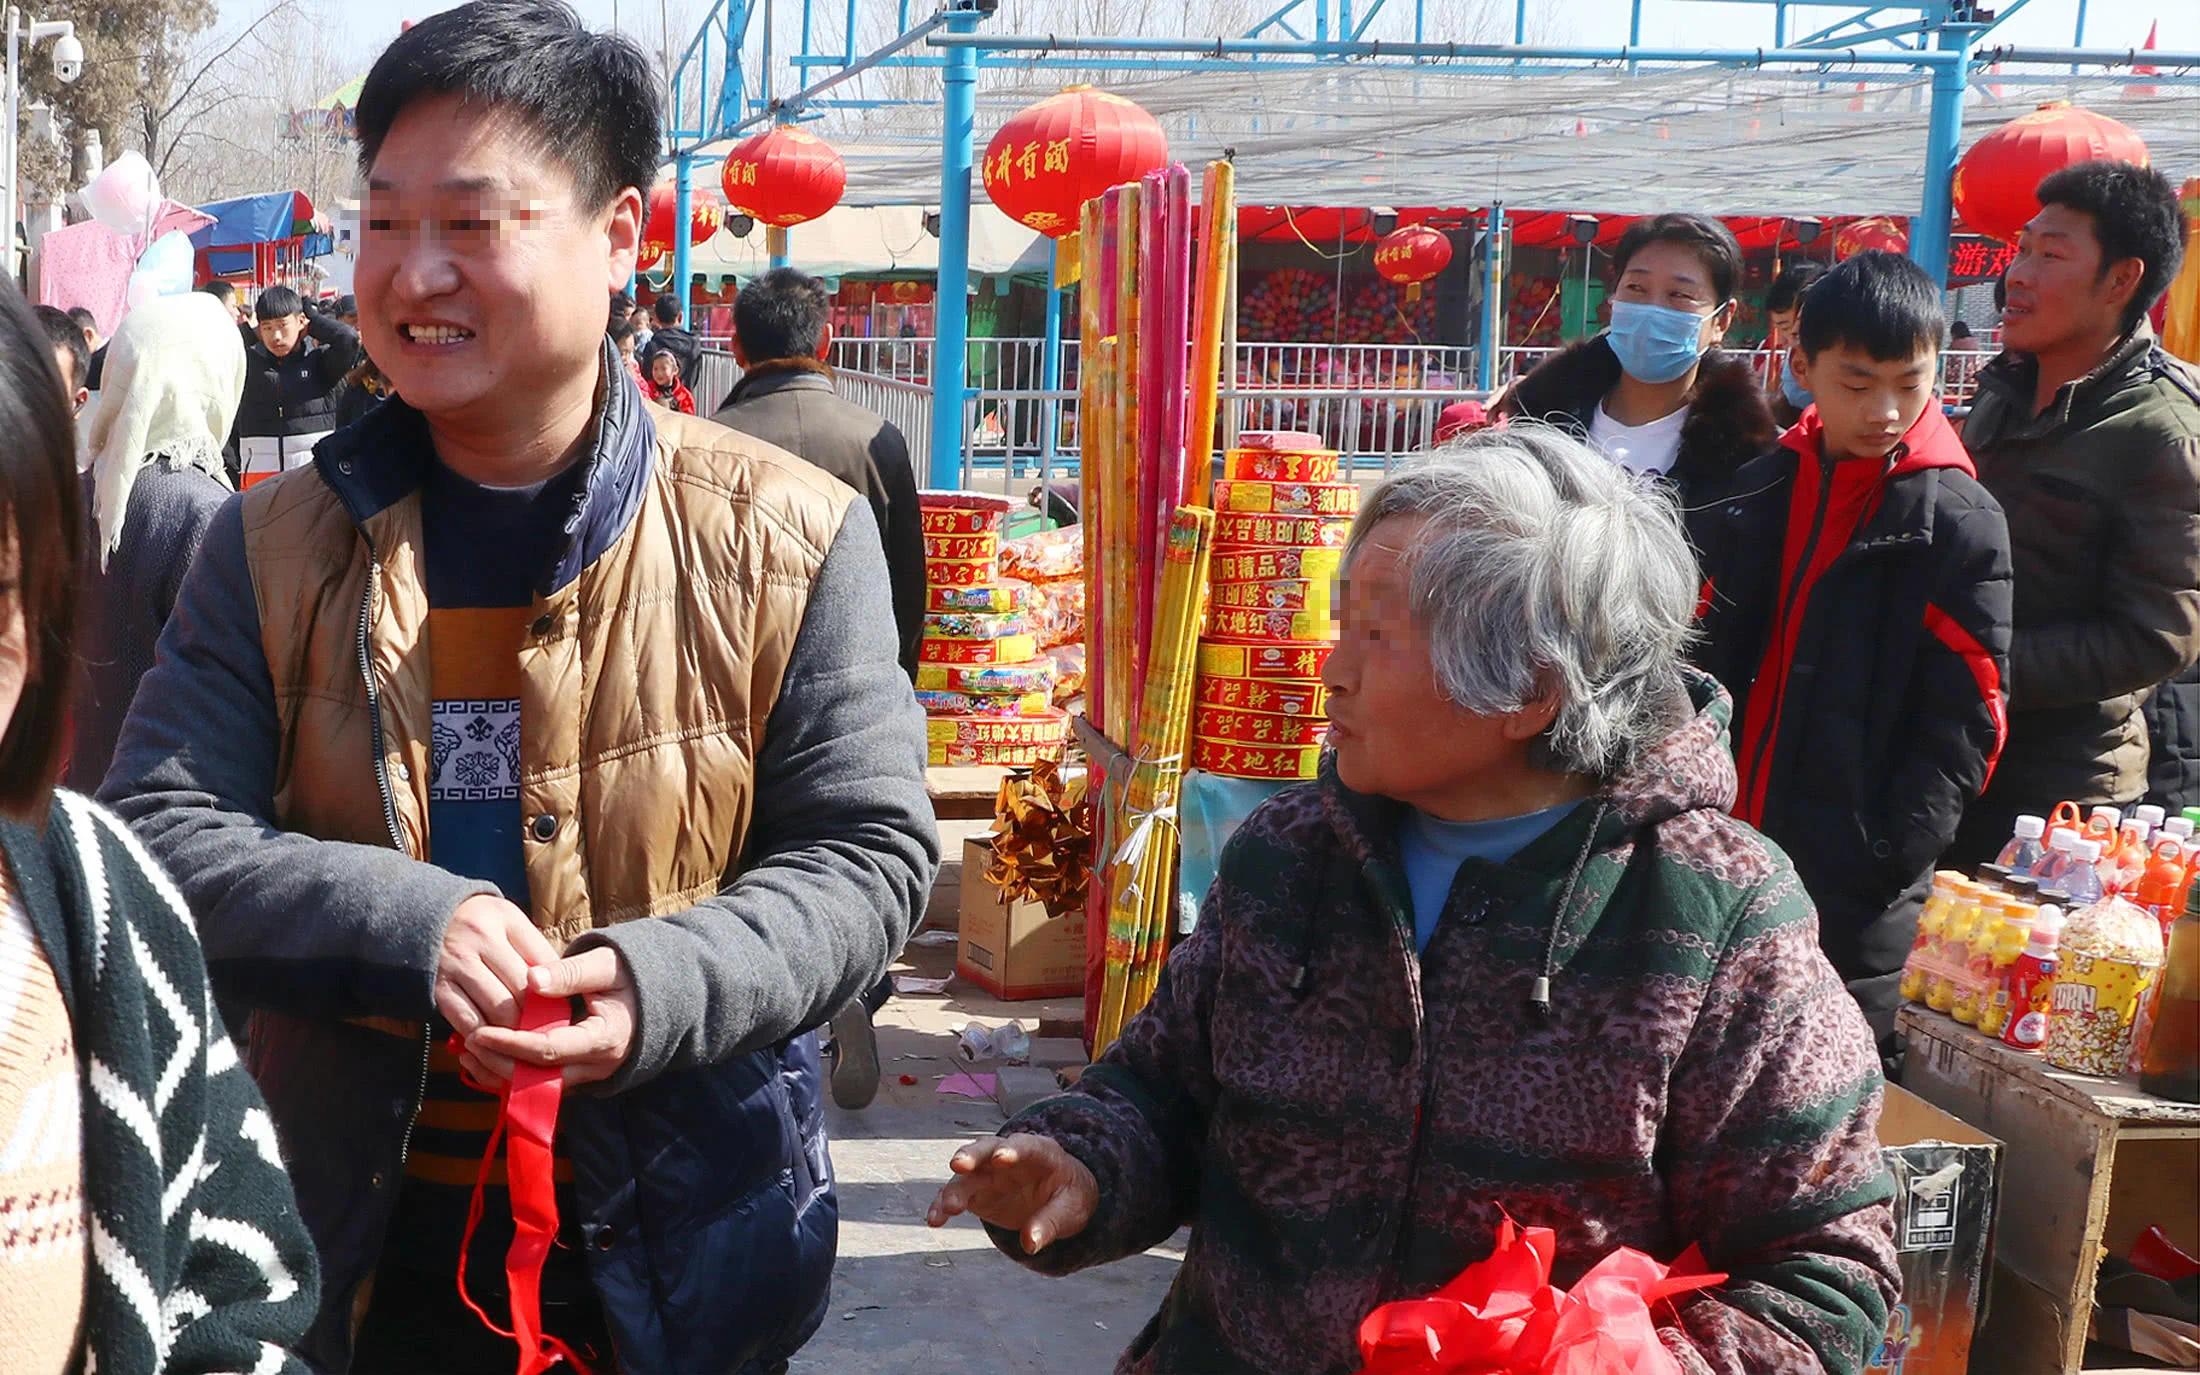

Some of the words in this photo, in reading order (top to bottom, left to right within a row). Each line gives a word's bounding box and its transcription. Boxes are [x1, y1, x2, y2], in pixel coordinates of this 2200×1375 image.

[1216, 518, 1316, 544] 浏阳精品大
[1214, 555, 1277, 579] 阳精品
[1294, 649, 1317, 676] 精
